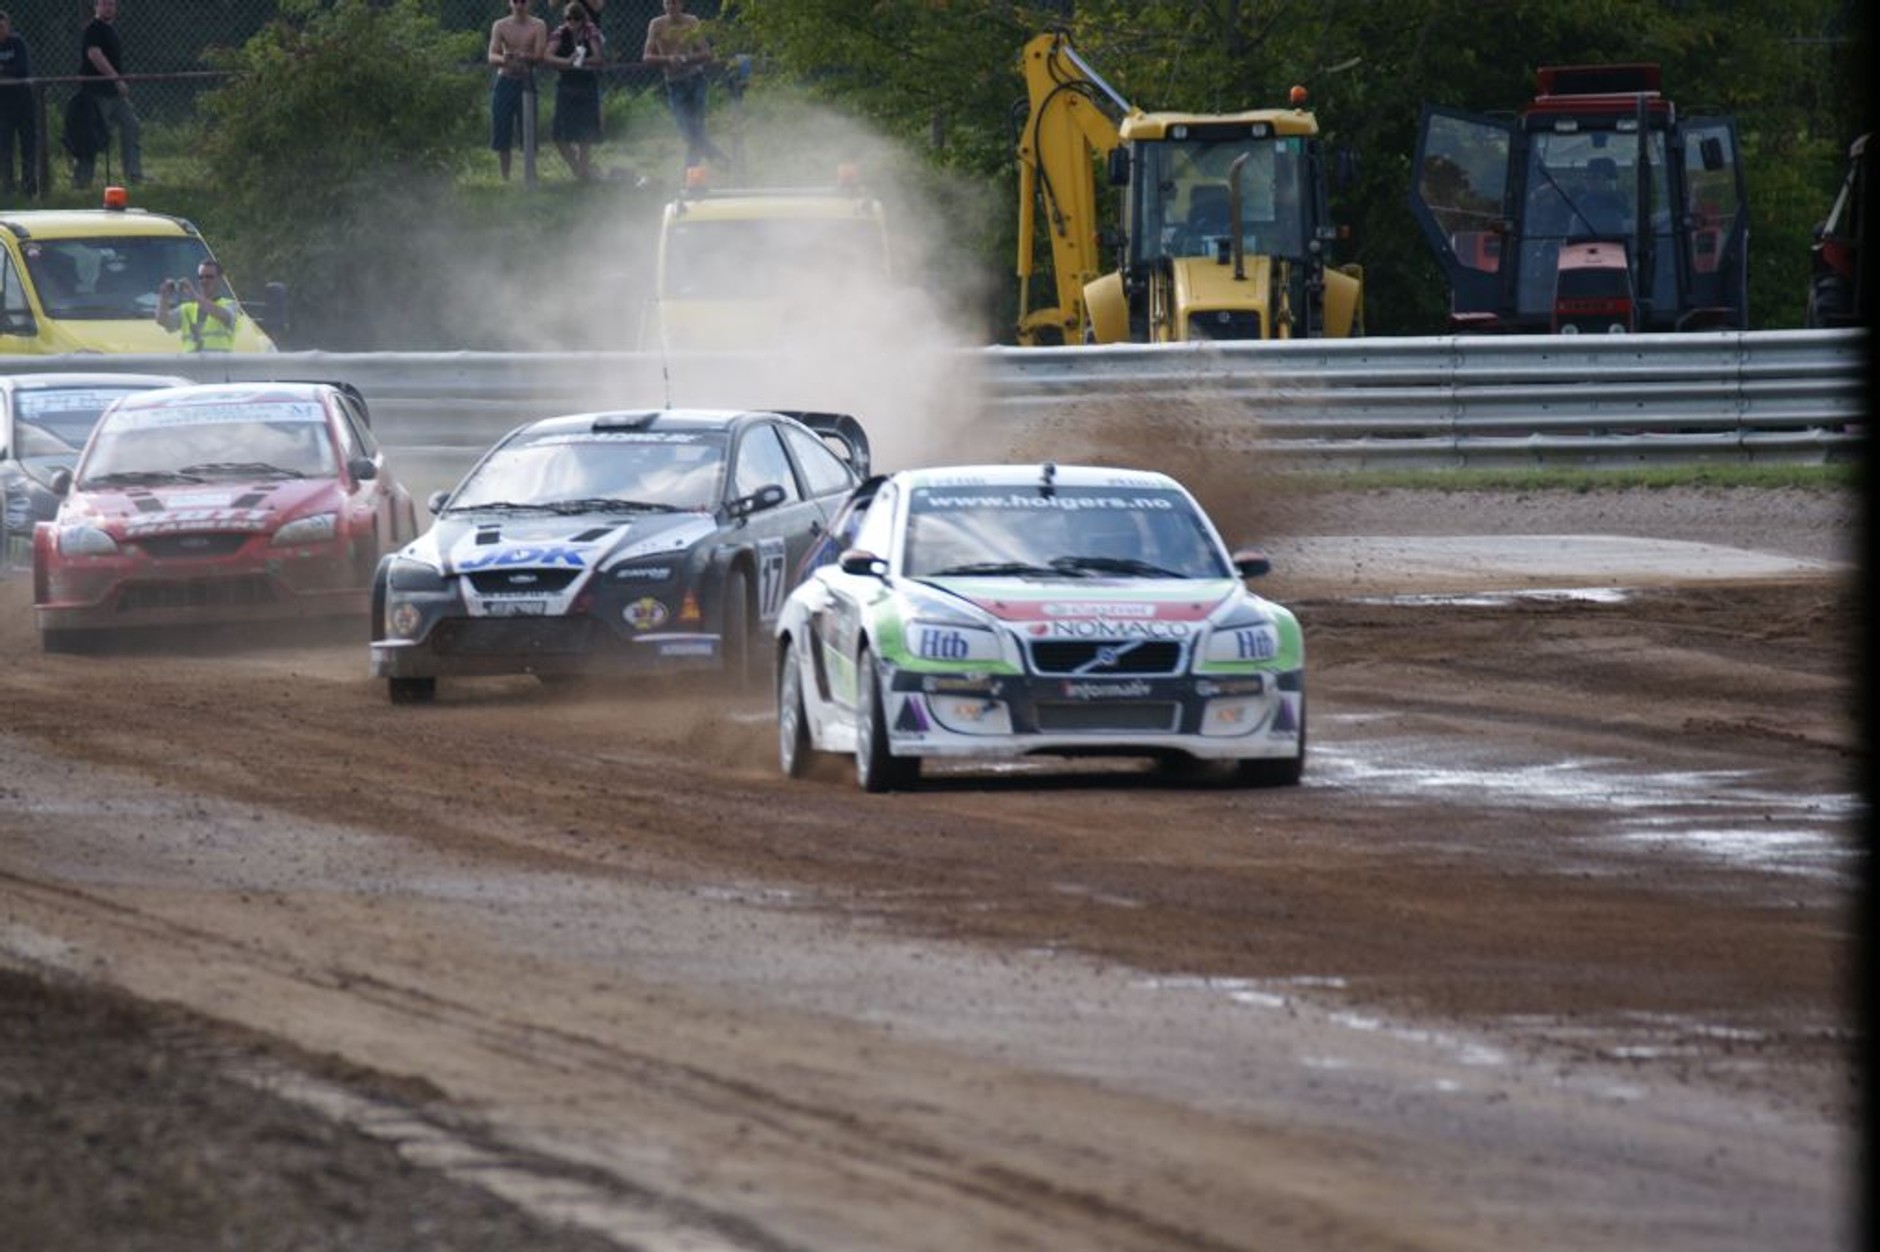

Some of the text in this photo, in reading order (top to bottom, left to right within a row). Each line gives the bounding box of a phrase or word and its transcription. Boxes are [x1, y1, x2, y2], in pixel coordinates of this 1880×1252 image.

[928, 495, 1172, 511] www.holgers.no
[459, 548, 586, 569] JDK
[763, 557, 784, 615] 17
[1053, 619, 1189, 639] NOMACO
[921, 629, 969, 658] Htb
